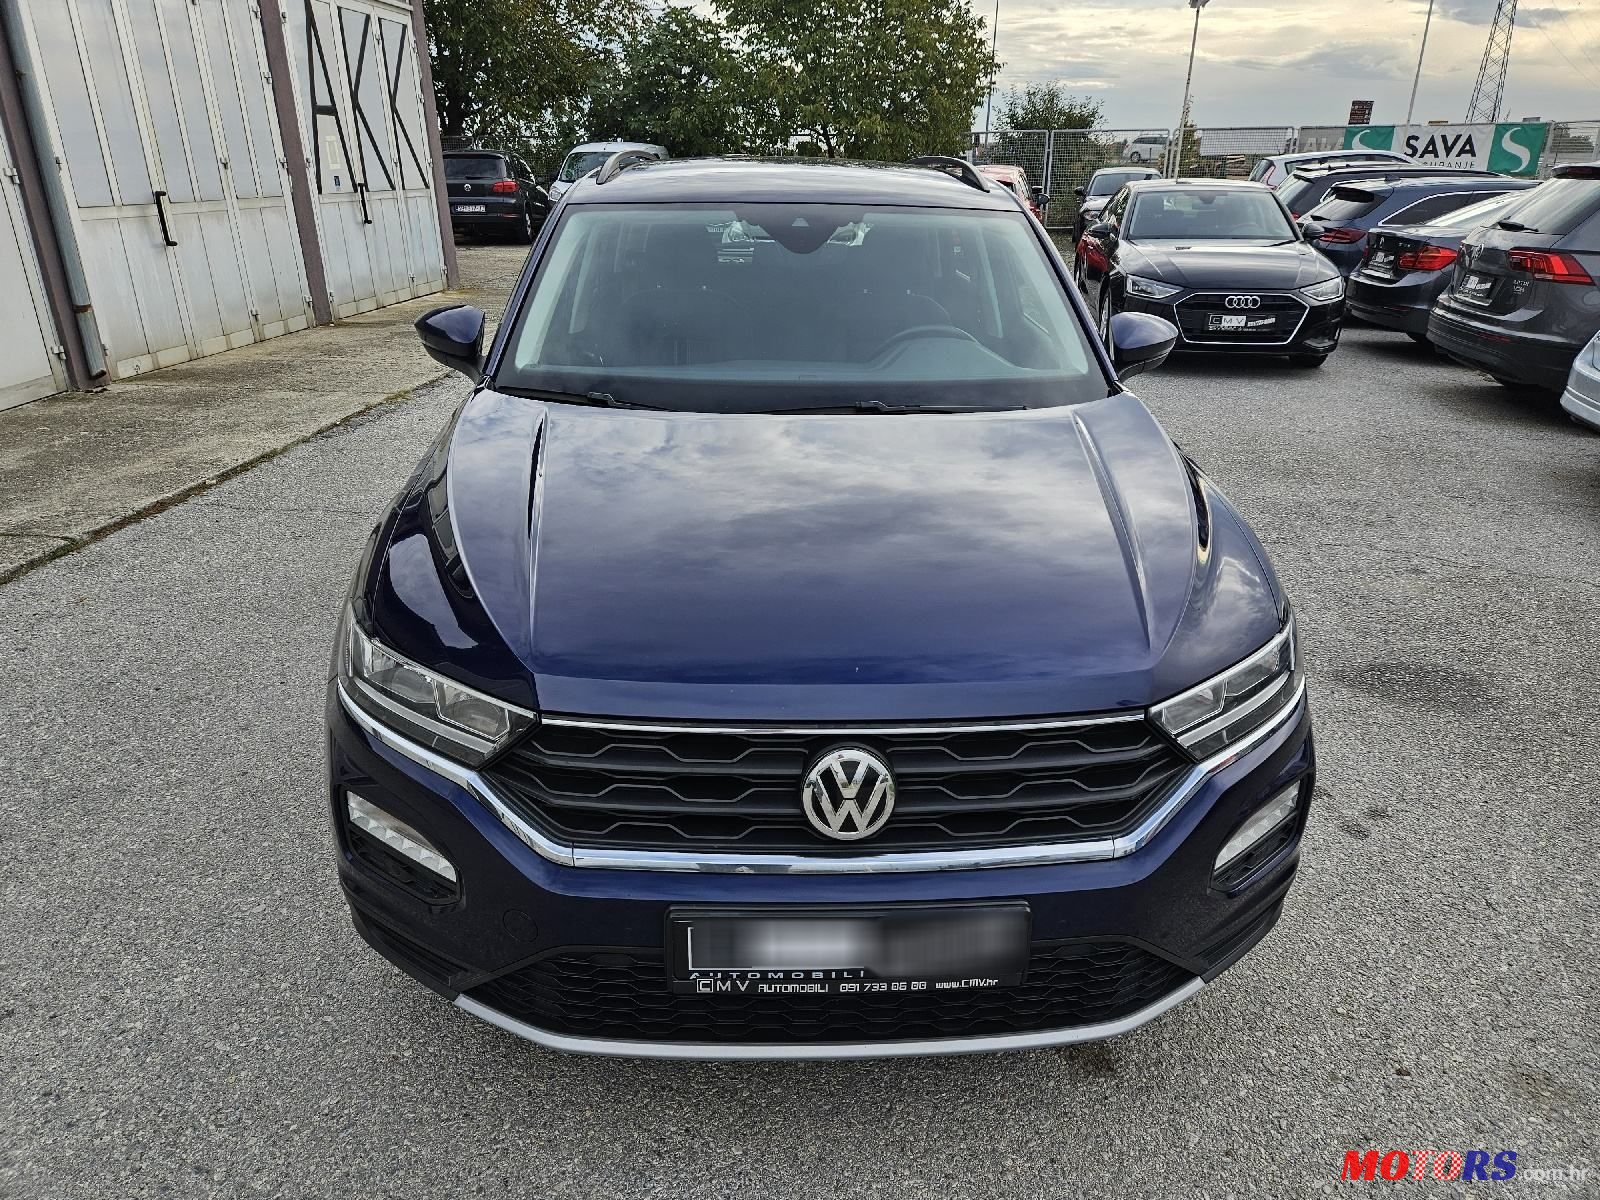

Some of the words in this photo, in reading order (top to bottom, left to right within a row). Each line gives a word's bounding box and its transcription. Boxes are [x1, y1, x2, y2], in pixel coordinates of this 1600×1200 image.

[1404, 134, 1476, 158] SAVA
[758, 984, 828, 992] AUTOMOBILI
[840, 984, 860, 992] 091
[864, 983, 887, 991] 733
